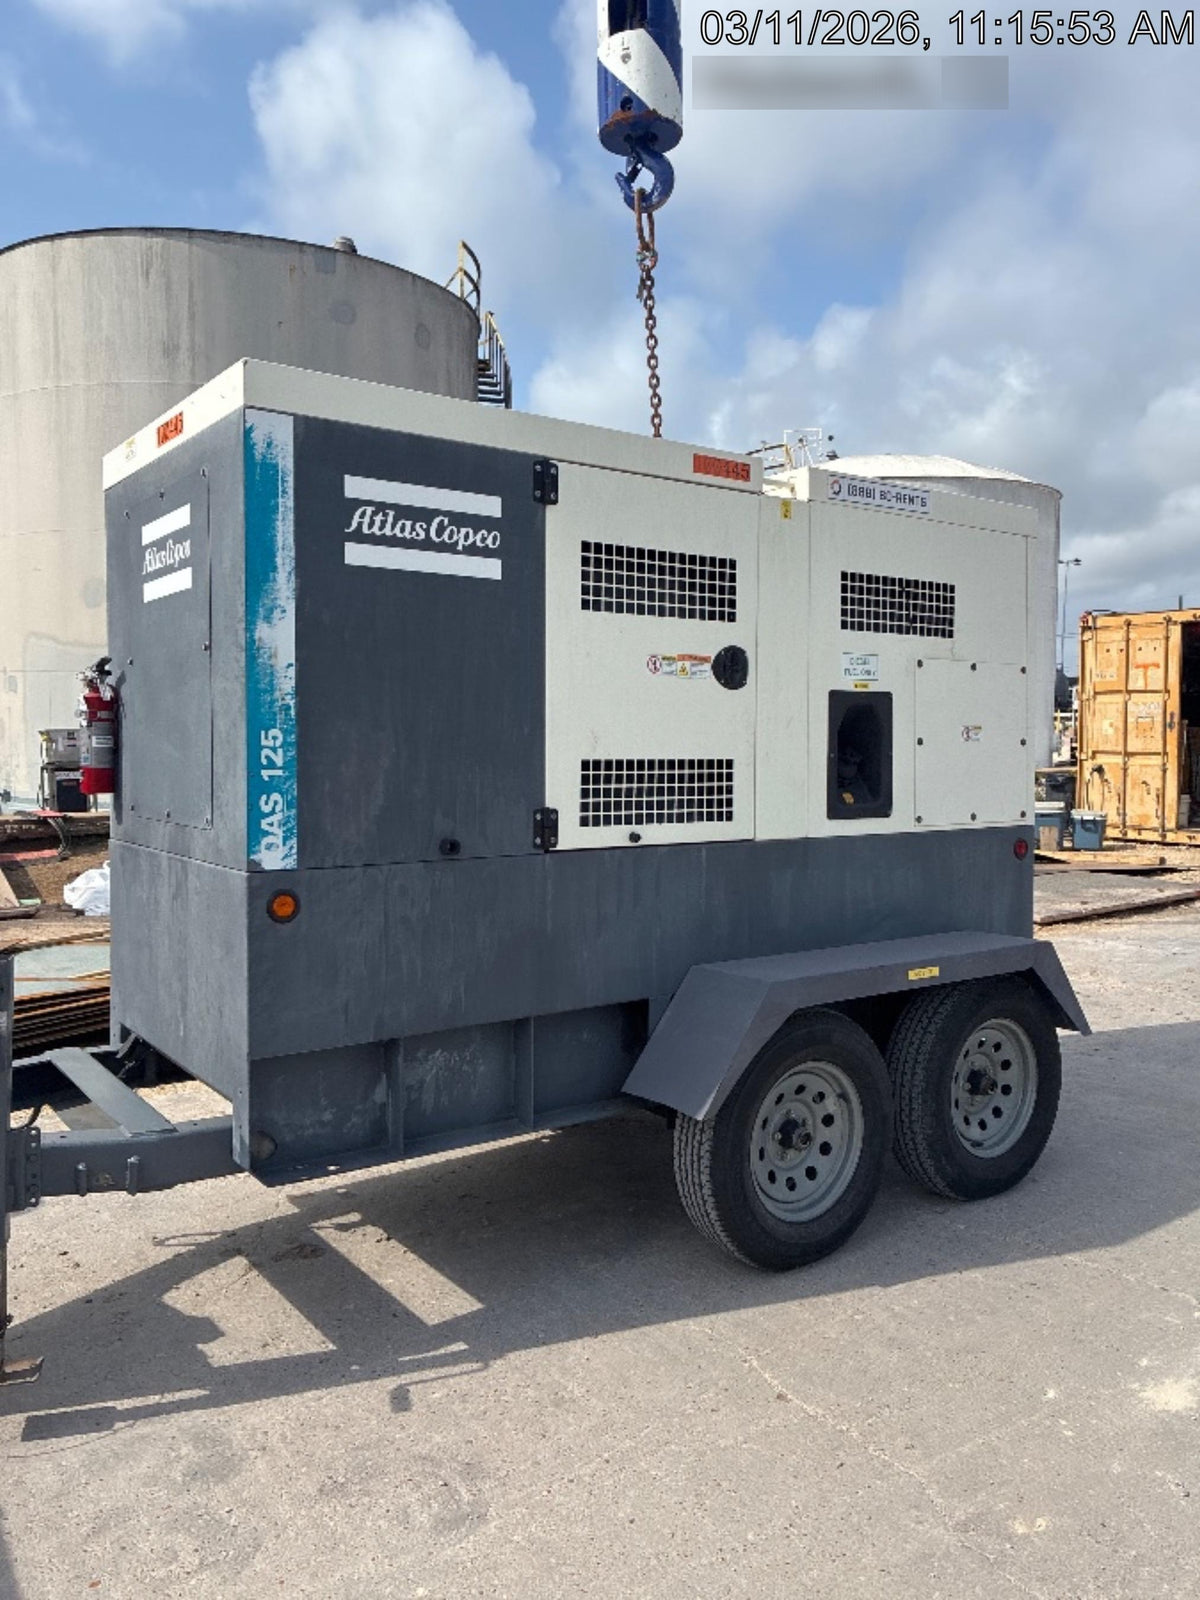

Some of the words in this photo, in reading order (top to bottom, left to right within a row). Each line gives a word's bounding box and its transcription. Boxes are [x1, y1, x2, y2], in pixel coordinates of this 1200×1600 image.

[344, 505, 427, 540] Atlas
[429, 514, 501, 551] Copco
[260, 728, 284, 782] 125
